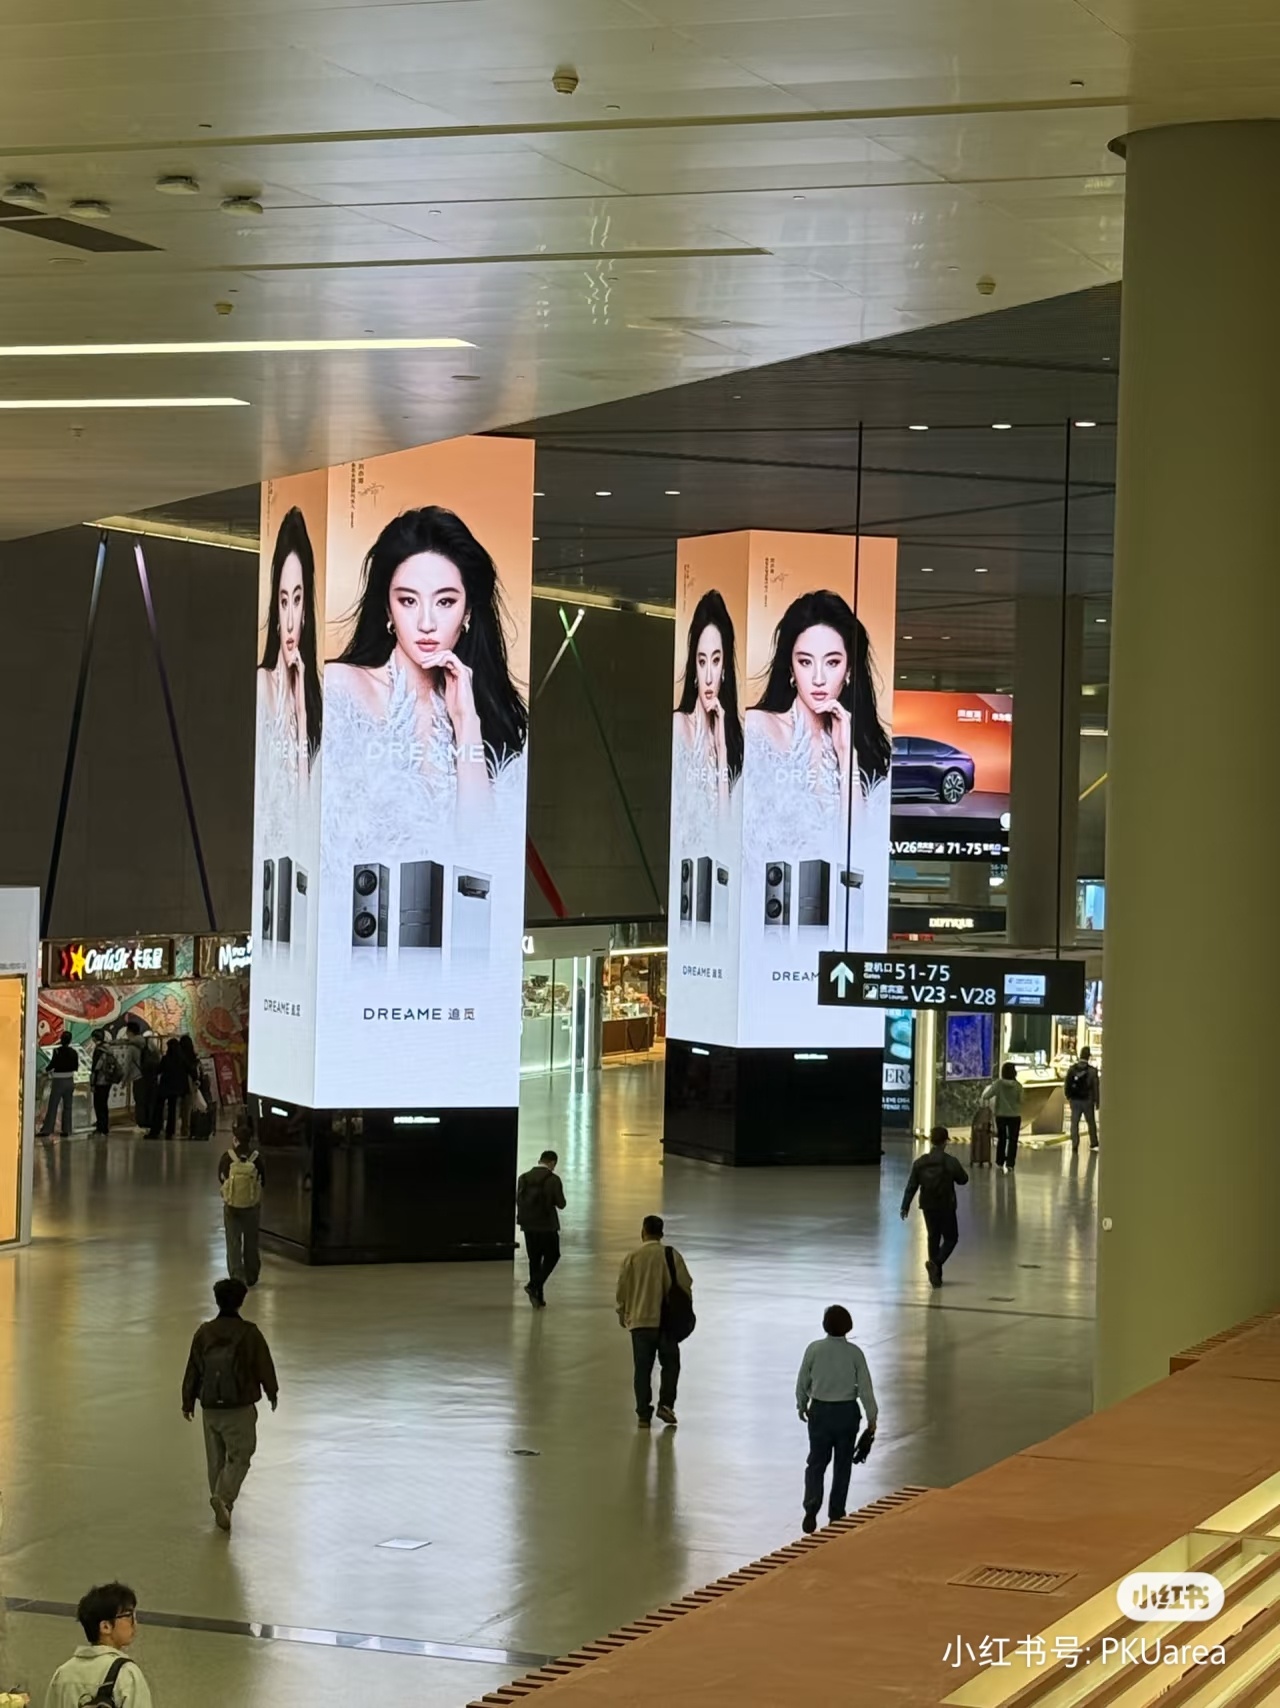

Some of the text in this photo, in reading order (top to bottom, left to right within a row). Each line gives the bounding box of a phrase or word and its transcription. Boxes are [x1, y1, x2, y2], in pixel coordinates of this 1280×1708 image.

[947, 842, 982, 856] 71-75
[683, 965, 711, 978] DREAME
[864, 961, 951, 982] 登机口 51-75
[911, 985, 946, 1004] V23
[961, 987, 997, 1006] V28
[264, 999, 290, 1016] DREAME
[363, 1008, 442, 1021] DREAME
